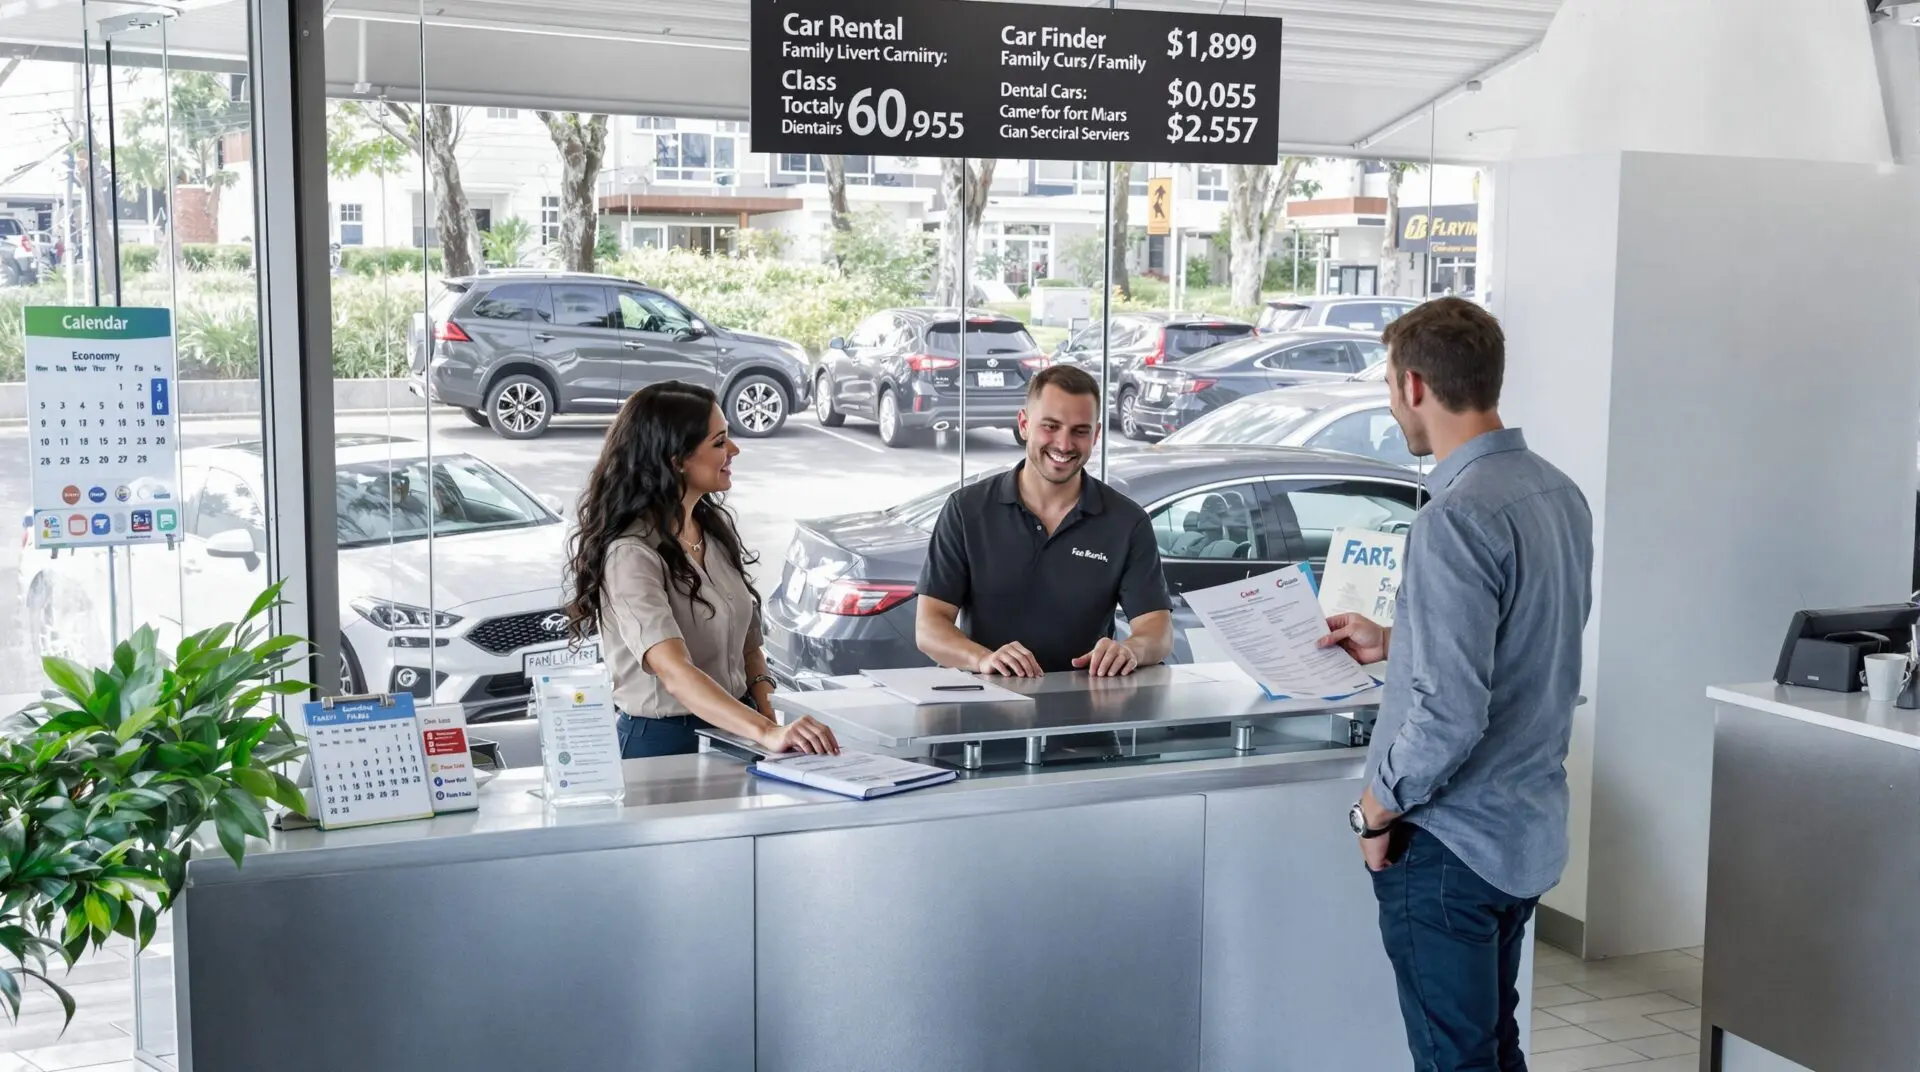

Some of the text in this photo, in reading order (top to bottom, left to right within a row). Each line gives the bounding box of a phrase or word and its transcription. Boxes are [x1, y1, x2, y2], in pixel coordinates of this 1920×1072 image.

[783, 13, 902, 40] Car Rental
[1001, 25, 1106, 49] Car Finder
[1167, 27, 1256, 62] $1,899
[782, 42, 834, 62] Family
[838, 44, 880, 61] Livert
[1001, 50, 1050, 71] Family
[782, 70, 836, 90] Class
[1000, 82, 1087, 100] Dental Cars:
[1168, 78, 1256, 110] $0,055
[782, 96, 844, 119] Toctaly
[848, 87, 964, 141] 60,955
[1041, 105, 1060, 120] for
[1063, 106, 1088, 121] fort
[782, 120, 842, 135] Dientairs
[1000, 124, 1028, 139] Cian
[1082, 127, 1130, 142] Serviers
[1166, 112, 1258, 144] $2.557
[62, 314, 128, 330] Calendar
[136, 383, 142, 392] 2
[40, 438, 50, 446] 10
[60, 437, 68, 446] 11
[99, 437, 108, 446] 15
[156, 436, 166, 445] 20
[99, 456, 109, 464] 20
[118, 456, 128, 464] 27
